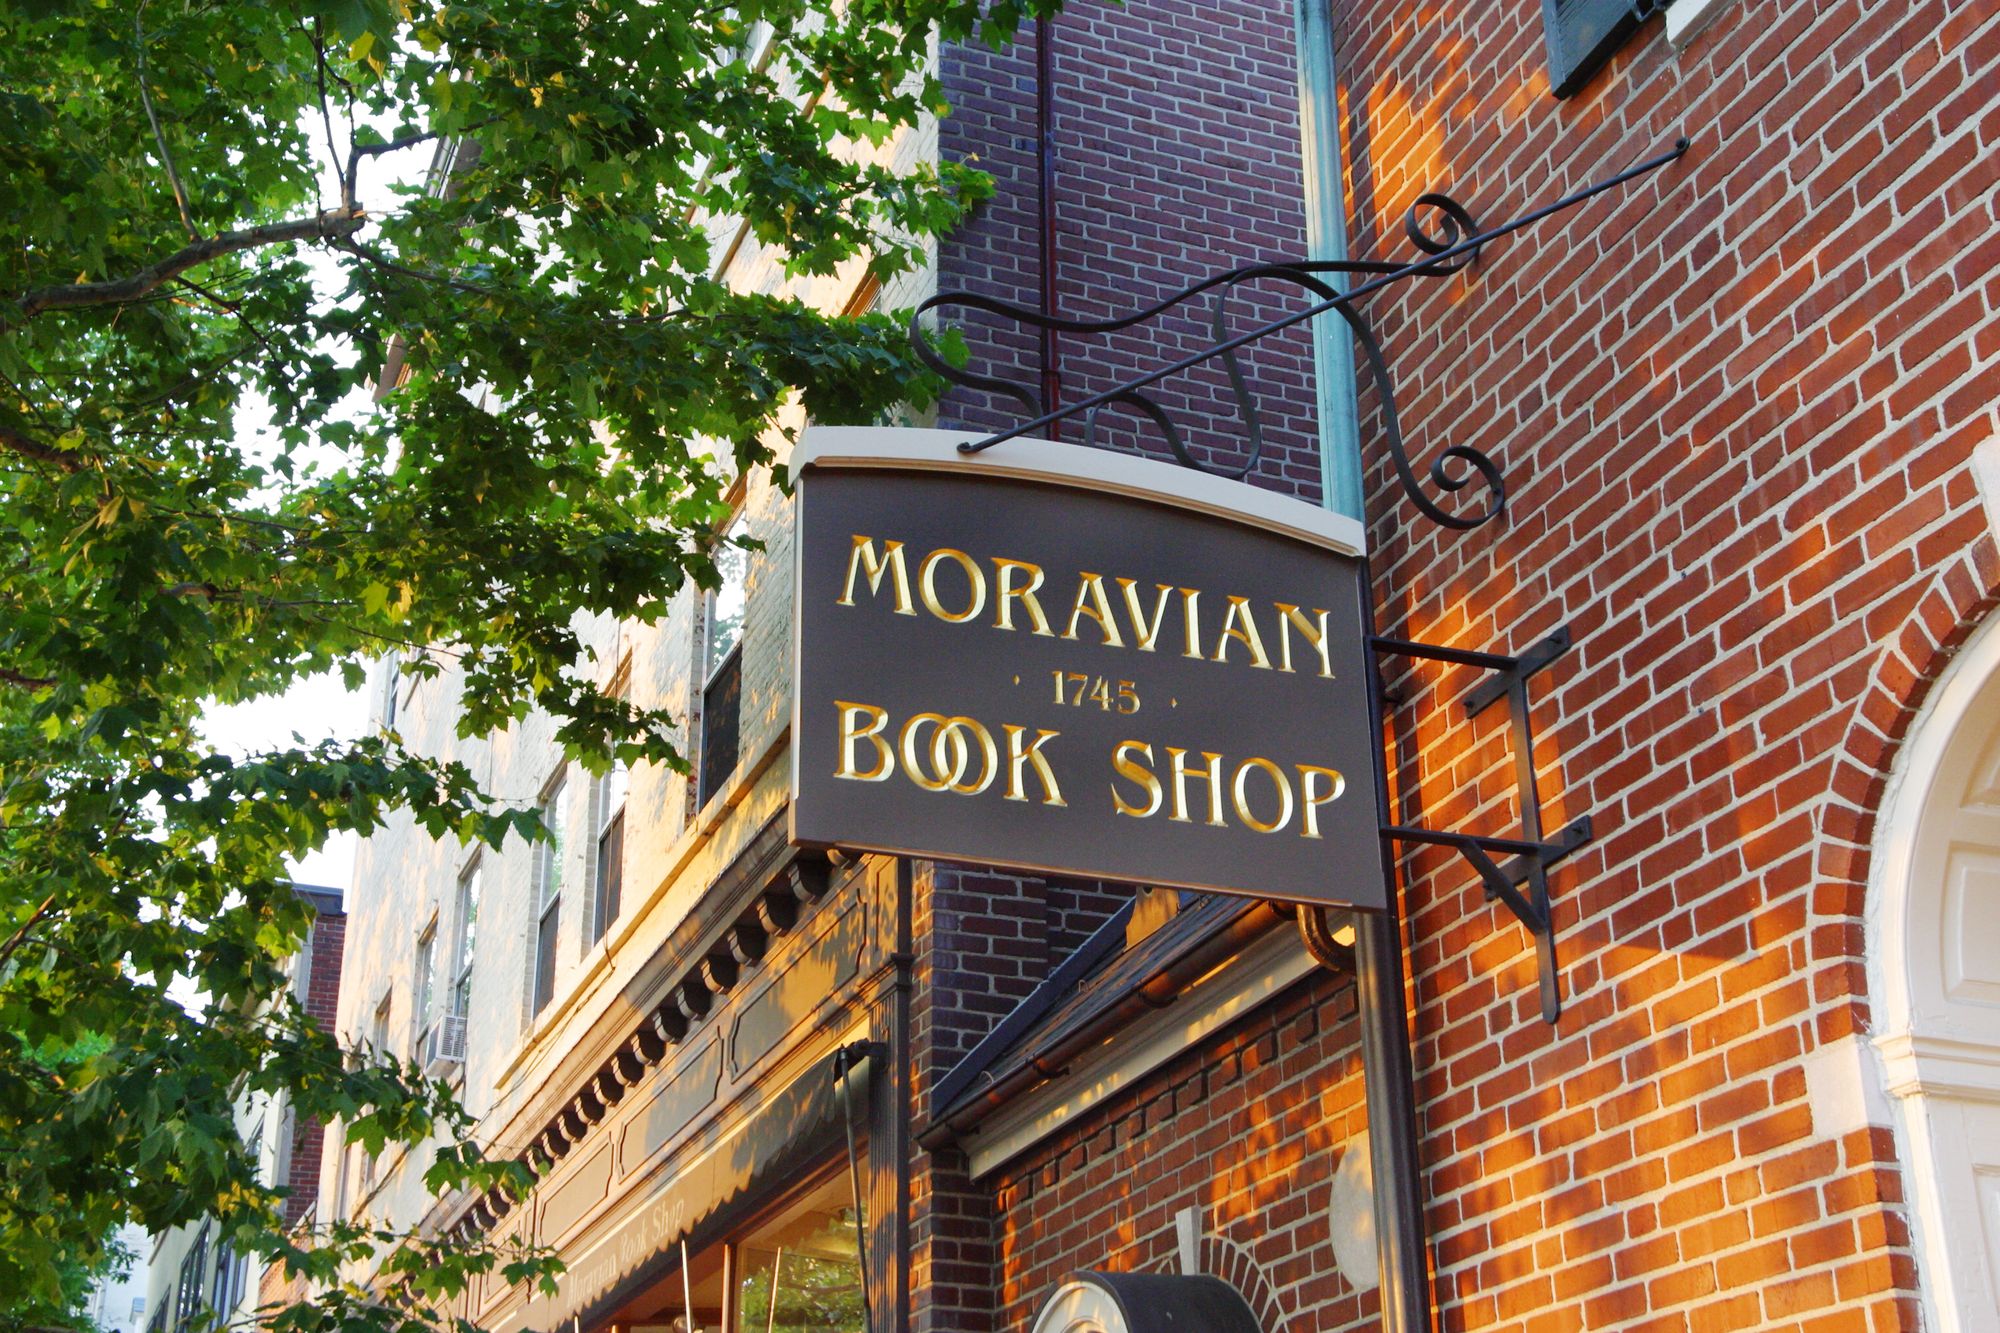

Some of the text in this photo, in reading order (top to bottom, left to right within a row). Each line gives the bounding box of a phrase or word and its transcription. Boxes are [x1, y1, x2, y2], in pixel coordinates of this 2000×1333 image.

[835, 533, 1337, 680] MORAVIAN
[1050, 669, 1142, 716] 1745
[832, 699, 1347, 840] BOOK SHOP
[652, 1197, 685, 1242] Shop
